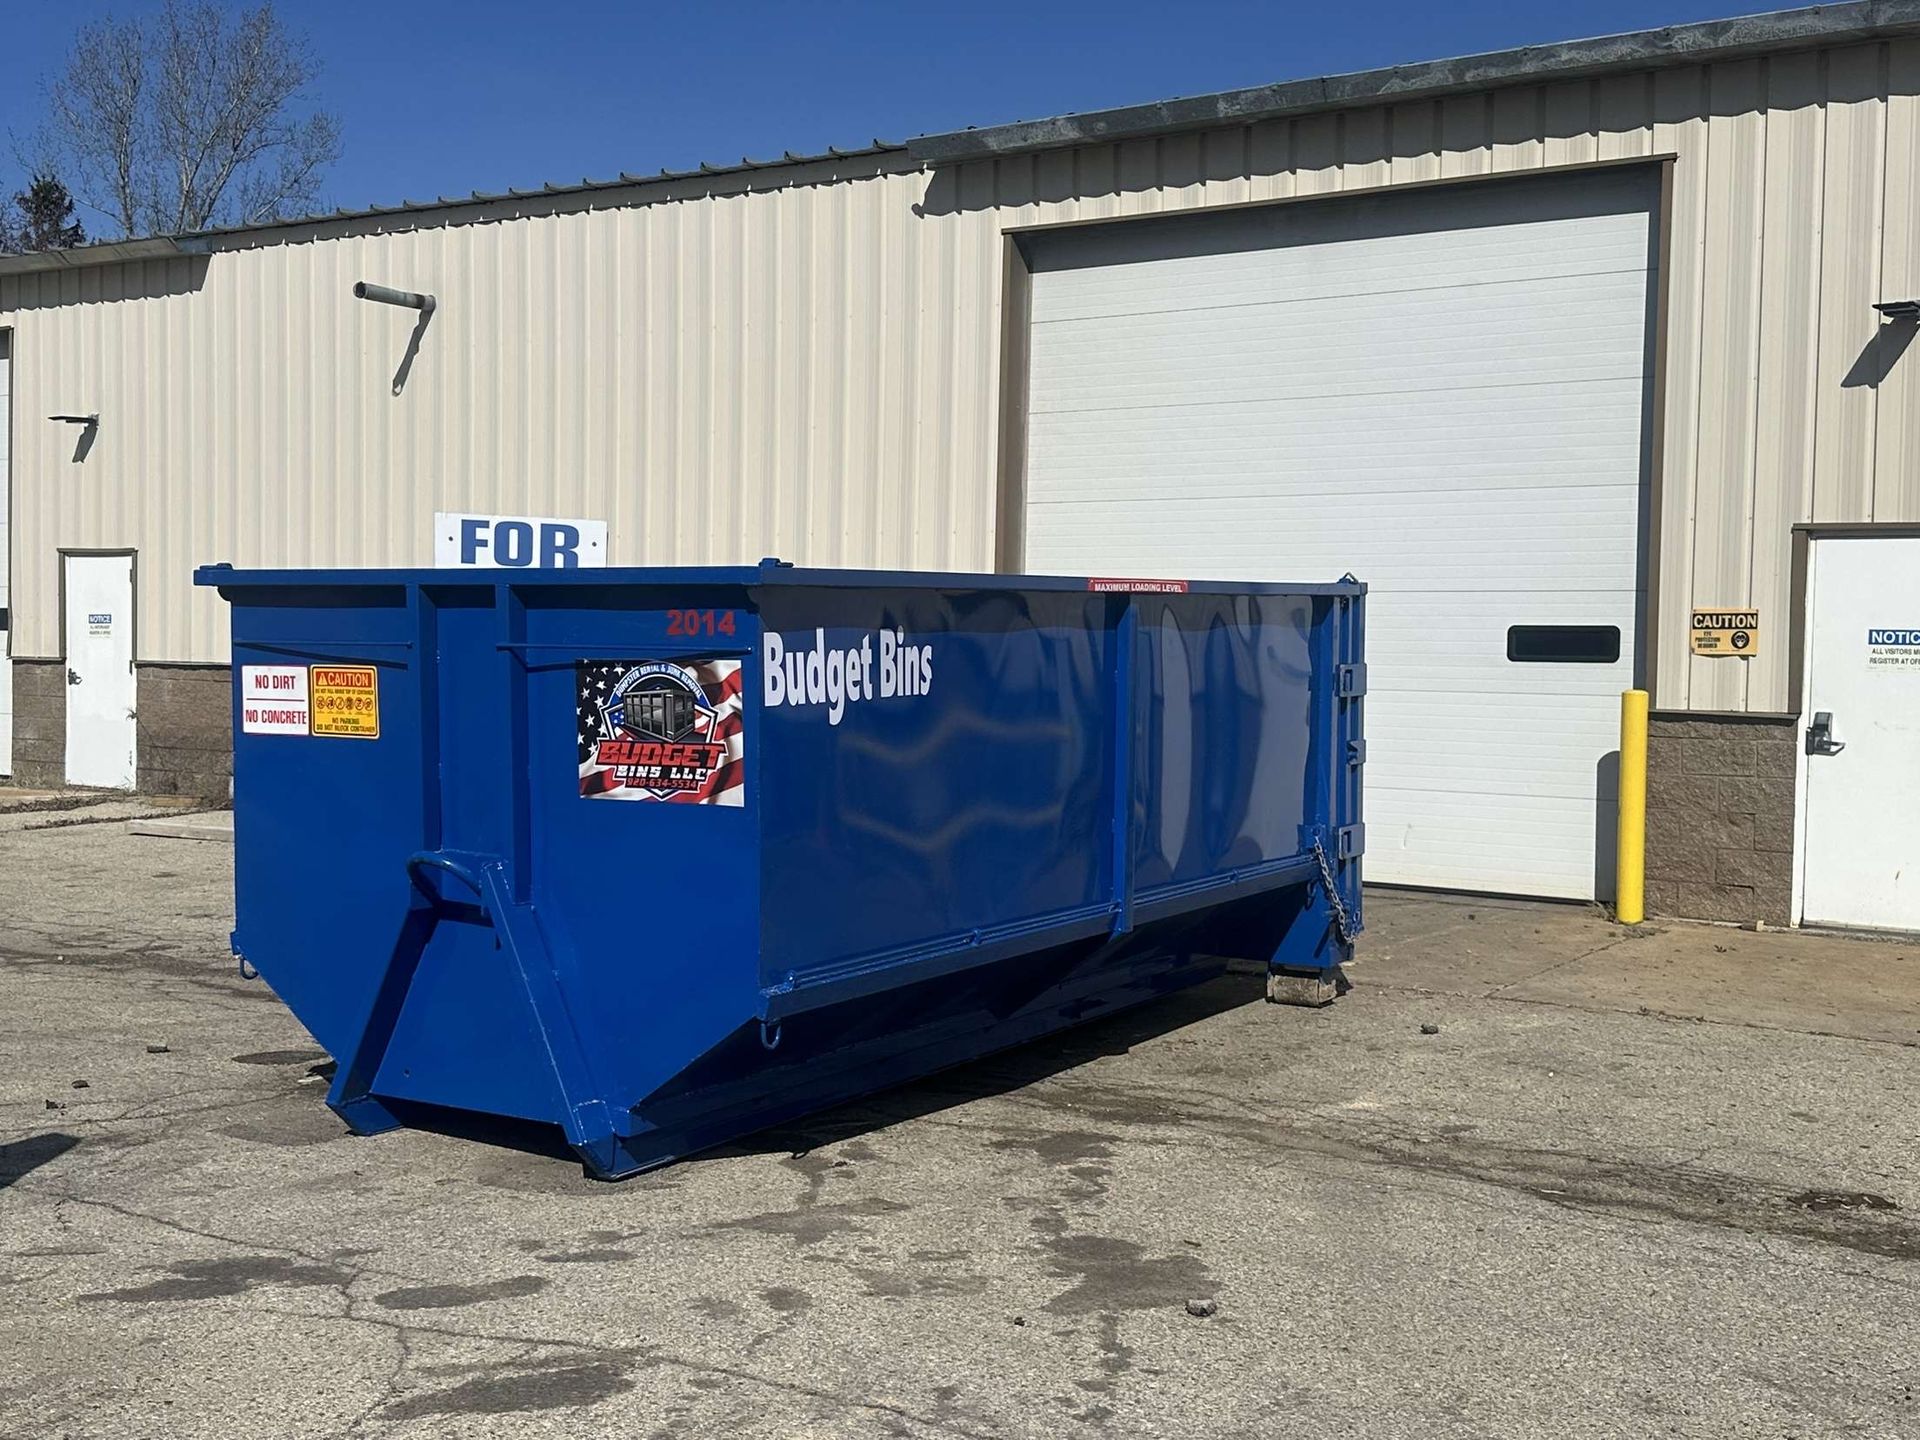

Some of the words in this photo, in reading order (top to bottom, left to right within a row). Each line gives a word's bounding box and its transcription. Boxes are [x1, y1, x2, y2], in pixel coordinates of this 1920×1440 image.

[461, 519, 580, 568] FOR
[1094, 583, 1130, 592] MAXIMUM
[1131, 583, 1160, 593] LOADING
[1162, 584, 1183, 593] LEVEL
[667, 609, 736, 636] 2014
[1694, 615, 1757, 628] CAUTION
[255, 674, 269, 689] NO
[273, 675, 296, 690] DIRT
[327, 673, 369, 686] CAUTION
[615, 670, 641, 697] DUMPSTER
[640, 664, 660, 676] RENTAL
[667, 665, 681, 679] JUNK
[680, 673, 702, 699] REMOVAL
[763, 627, 873, 726] Budget
[880, 625, 932, 697] Bins
[246, 709, 258, 723] NO
[261, 710, 307, 725] CONCRETE
[598, 742, 724, 767] BUDGET
[616, 765, 662, 778] BINS
[669, 768, 707, 780] LLC
[626, 778, 697, 788] 920-634-5534
